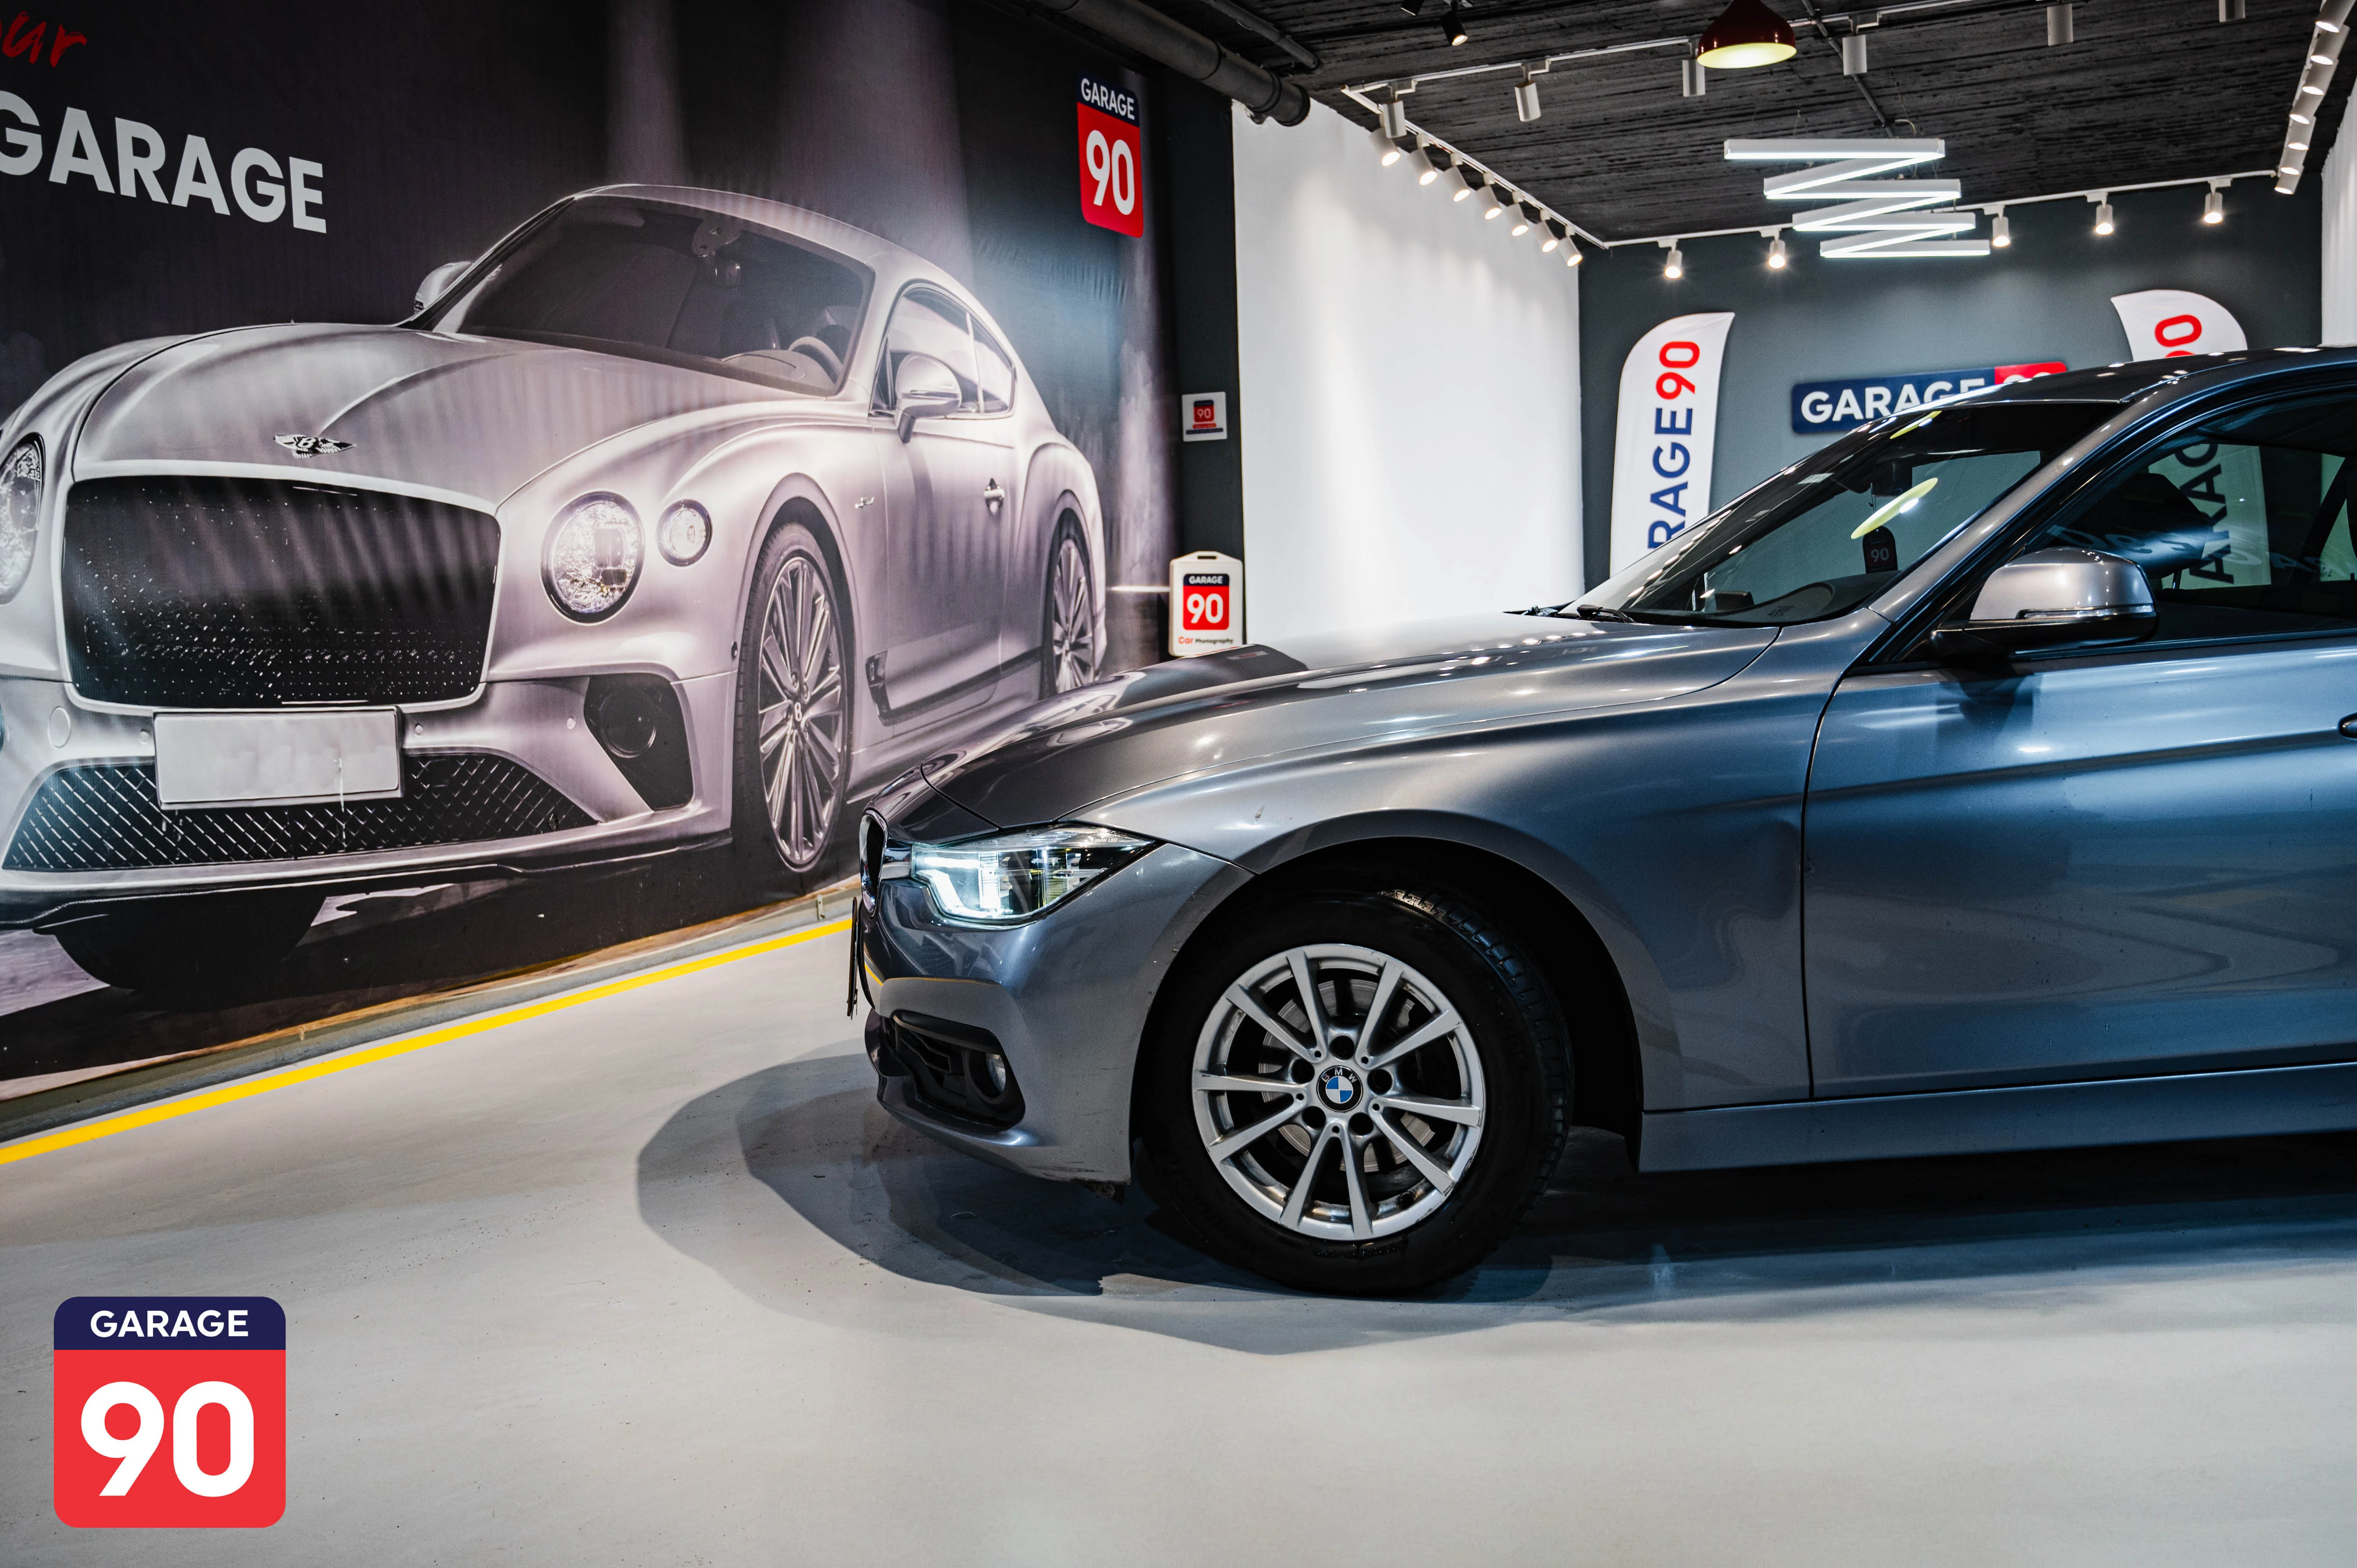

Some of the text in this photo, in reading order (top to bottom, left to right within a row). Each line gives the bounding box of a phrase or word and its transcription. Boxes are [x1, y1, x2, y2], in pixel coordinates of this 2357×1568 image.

[0, 11, 87, 67] ur
[1081, 78, 1135, 120] GARAGE
[0, 90, 327, 233] GARAGE
[1087, 130, 1135, 215] 90
[1197, 408, 1211, 419] 90
[1871, 547, 1889, 562] 90
[1189, 576, 1223, 584] GARAGE
[1187, 593, 1223, 623] 90
[1322, 1068, 1358, 1083] BMW
